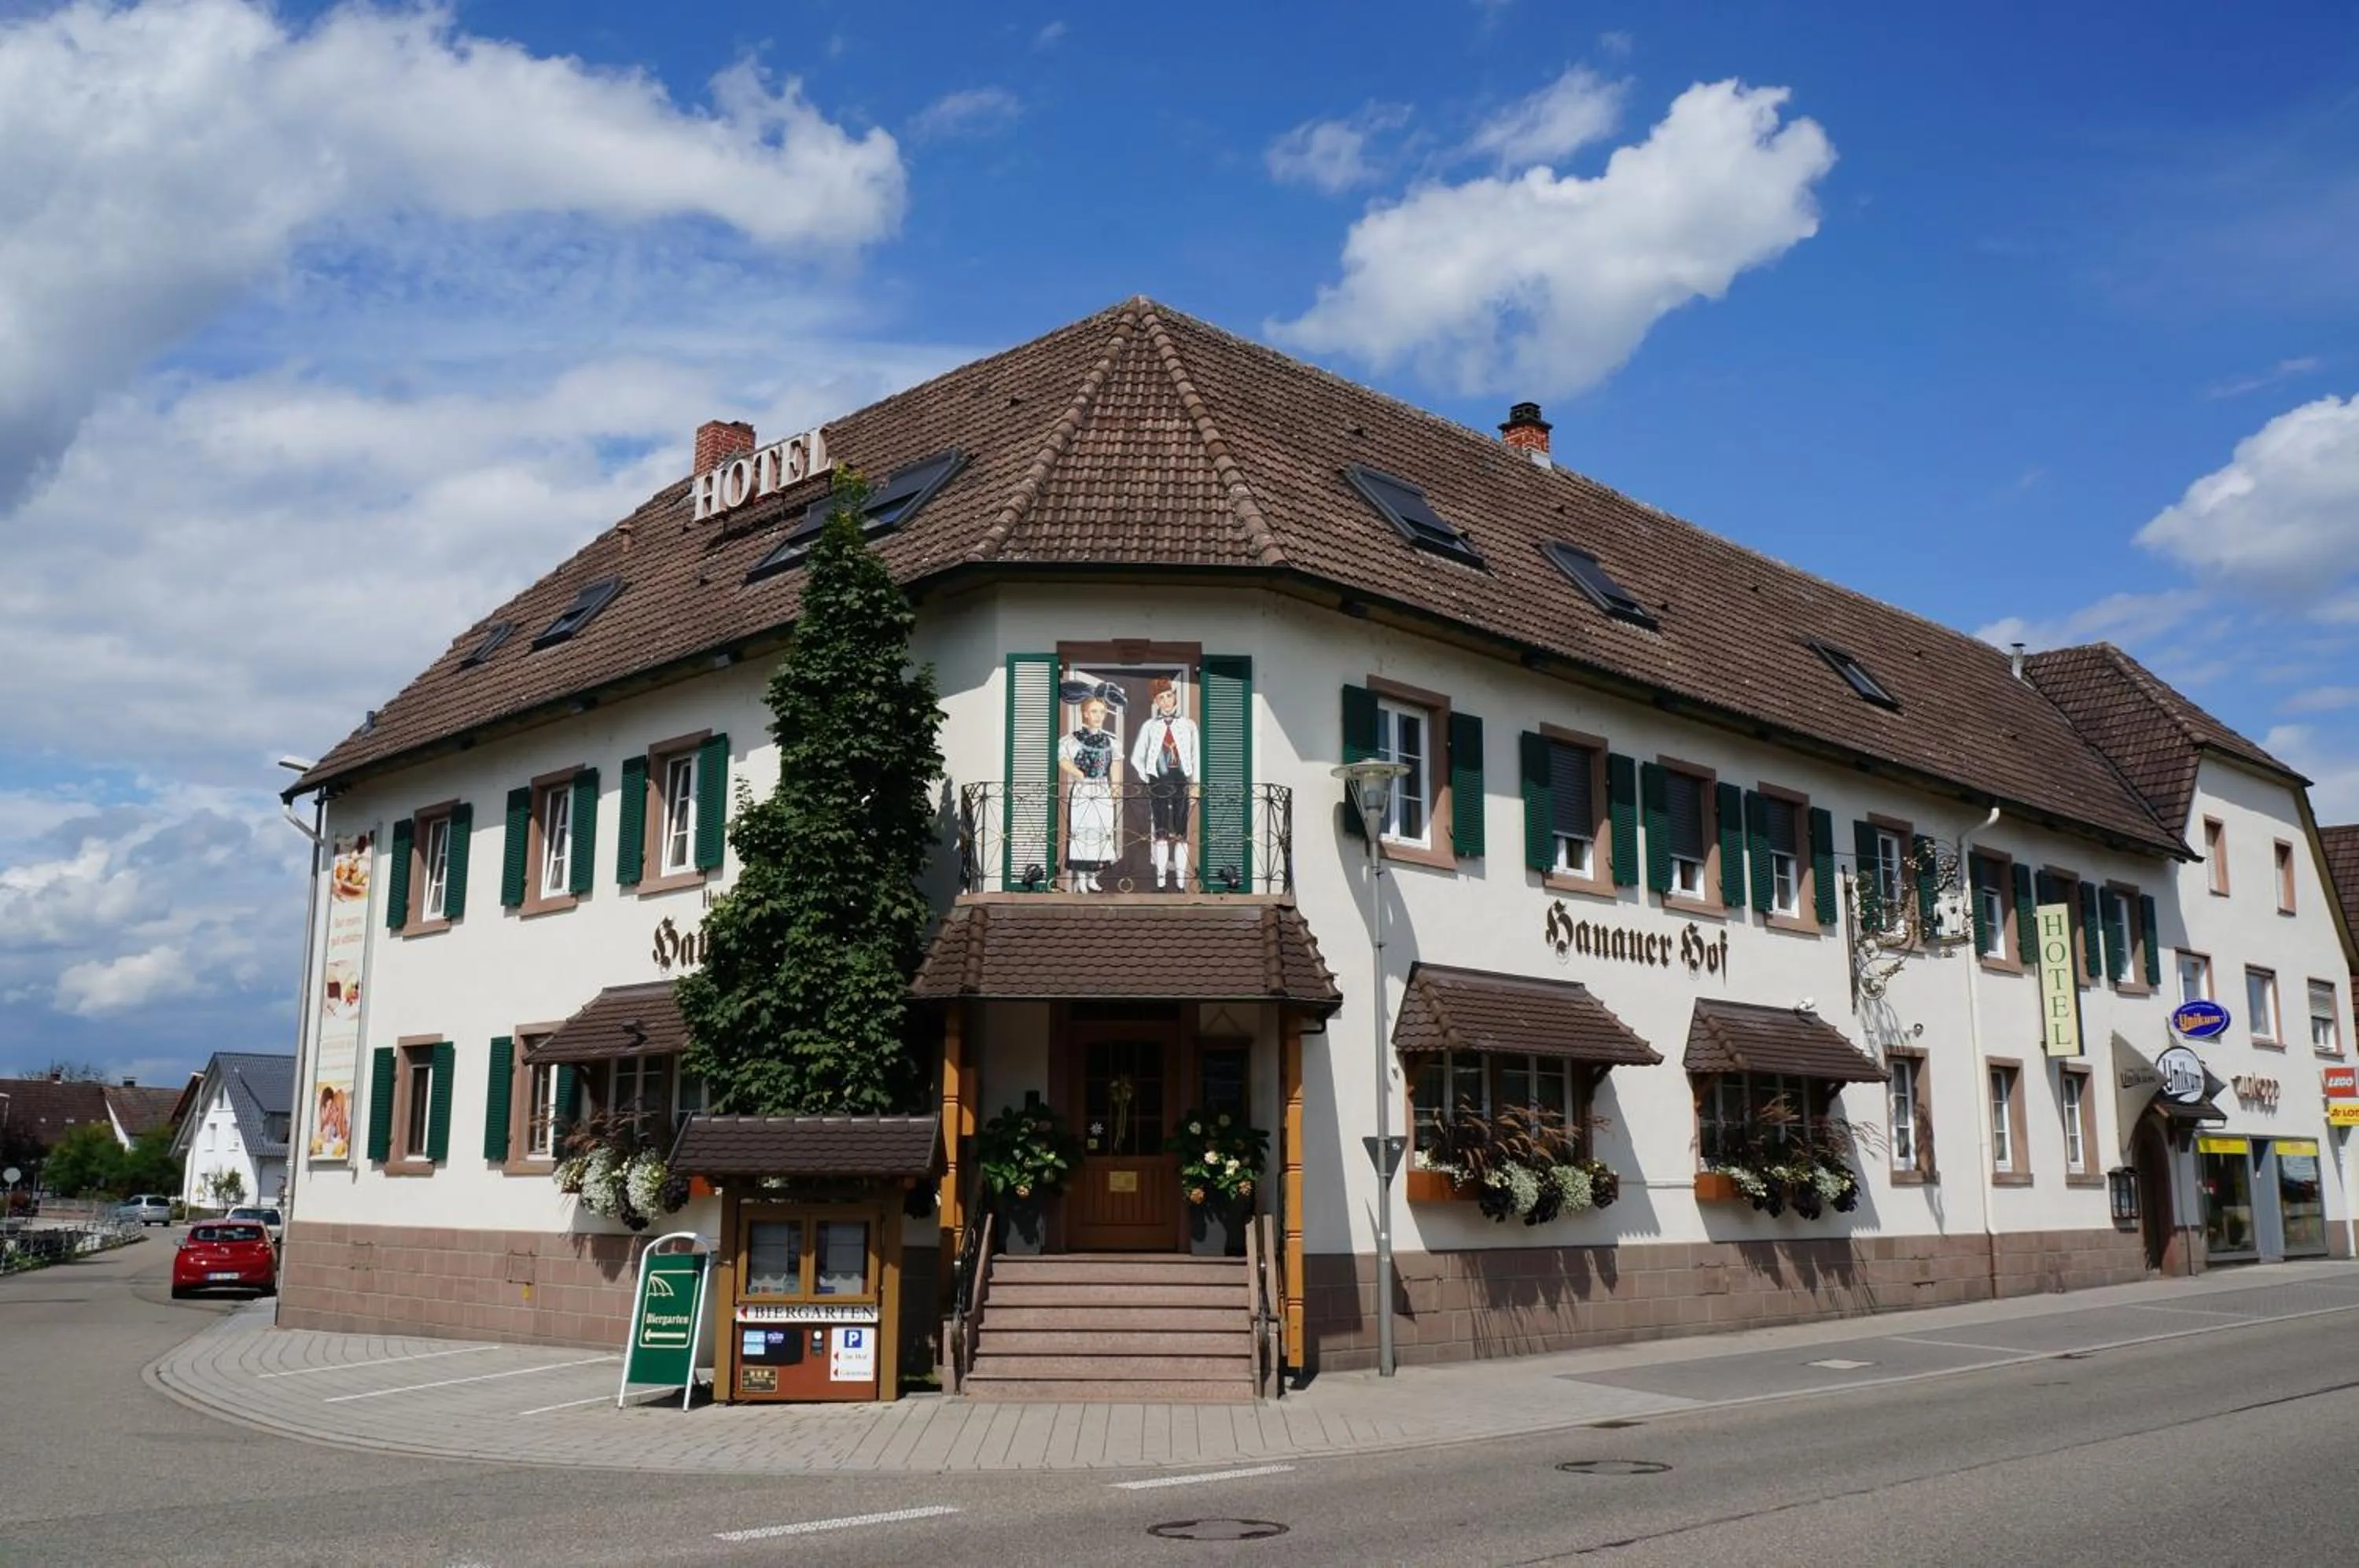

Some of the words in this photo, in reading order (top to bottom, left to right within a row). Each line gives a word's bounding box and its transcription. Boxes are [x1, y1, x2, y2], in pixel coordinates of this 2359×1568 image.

[692, 428, 831, 521] HOTEL
[1545, 900, 1673, 968] Hanauer
[1680, 922, 1728, 985] Hof
[2044, 914, 2072, 1045] HOTEL
[2179, 1013, 2221, 1032] Unikum
[2328, 1077, 2353, 1087] LEGO
[646, 1313, 689, 1327] Biergarten
[755, 1306, 875, 1319] BIERGARTEN
[848, 1331, 859, 1346] P
